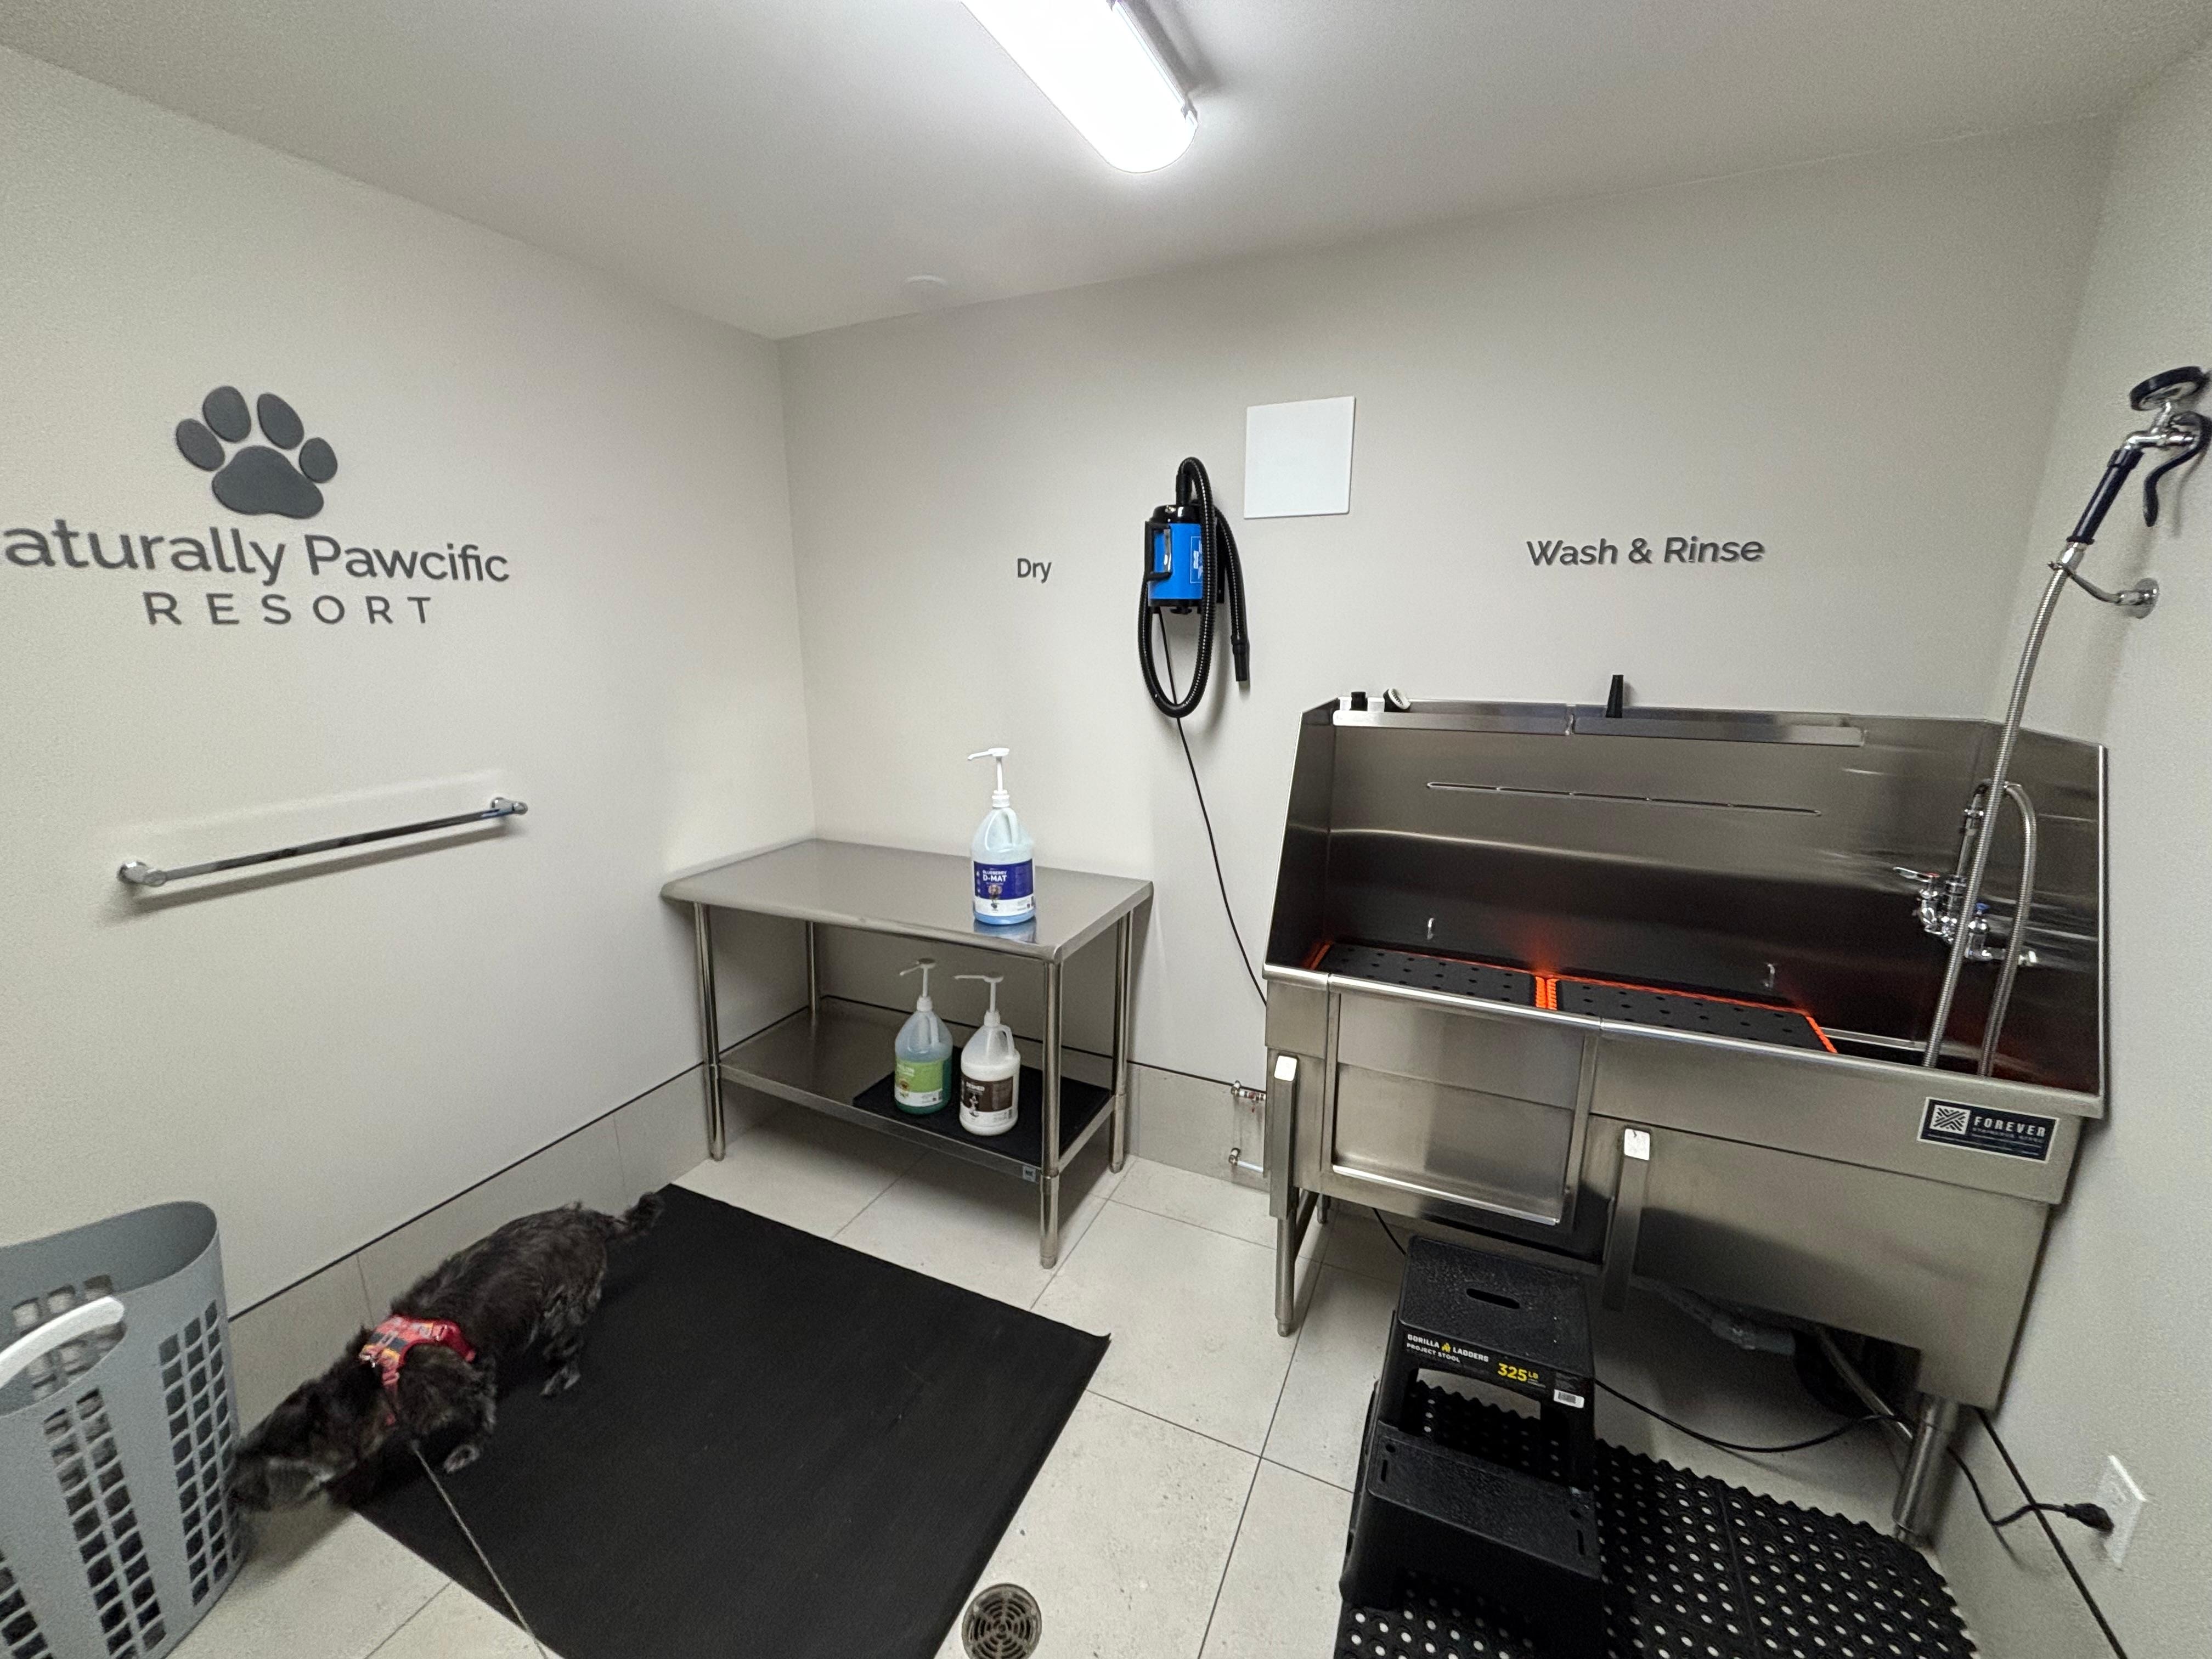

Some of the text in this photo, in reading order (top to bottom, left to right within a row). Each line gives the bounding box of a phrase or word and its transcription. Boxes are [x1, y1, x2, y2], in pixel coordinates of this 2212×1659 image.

[3, 519, 510, 586] aturally Pawcific
[1527, 535, 1766, 566] Wash & Rinse
[1017, 558, 1052, 584] Dry
[143, 591, 431, 625] RESORT
[1974, 1116, 2046, 1137] FOREVER
[1407, 1334, 1489, 1362] GORILLA LADDERS
[1407, 1342, 1460, 1363] PROJECT STOOL
[1497, 1363, 1539, 1382] 325 LB
